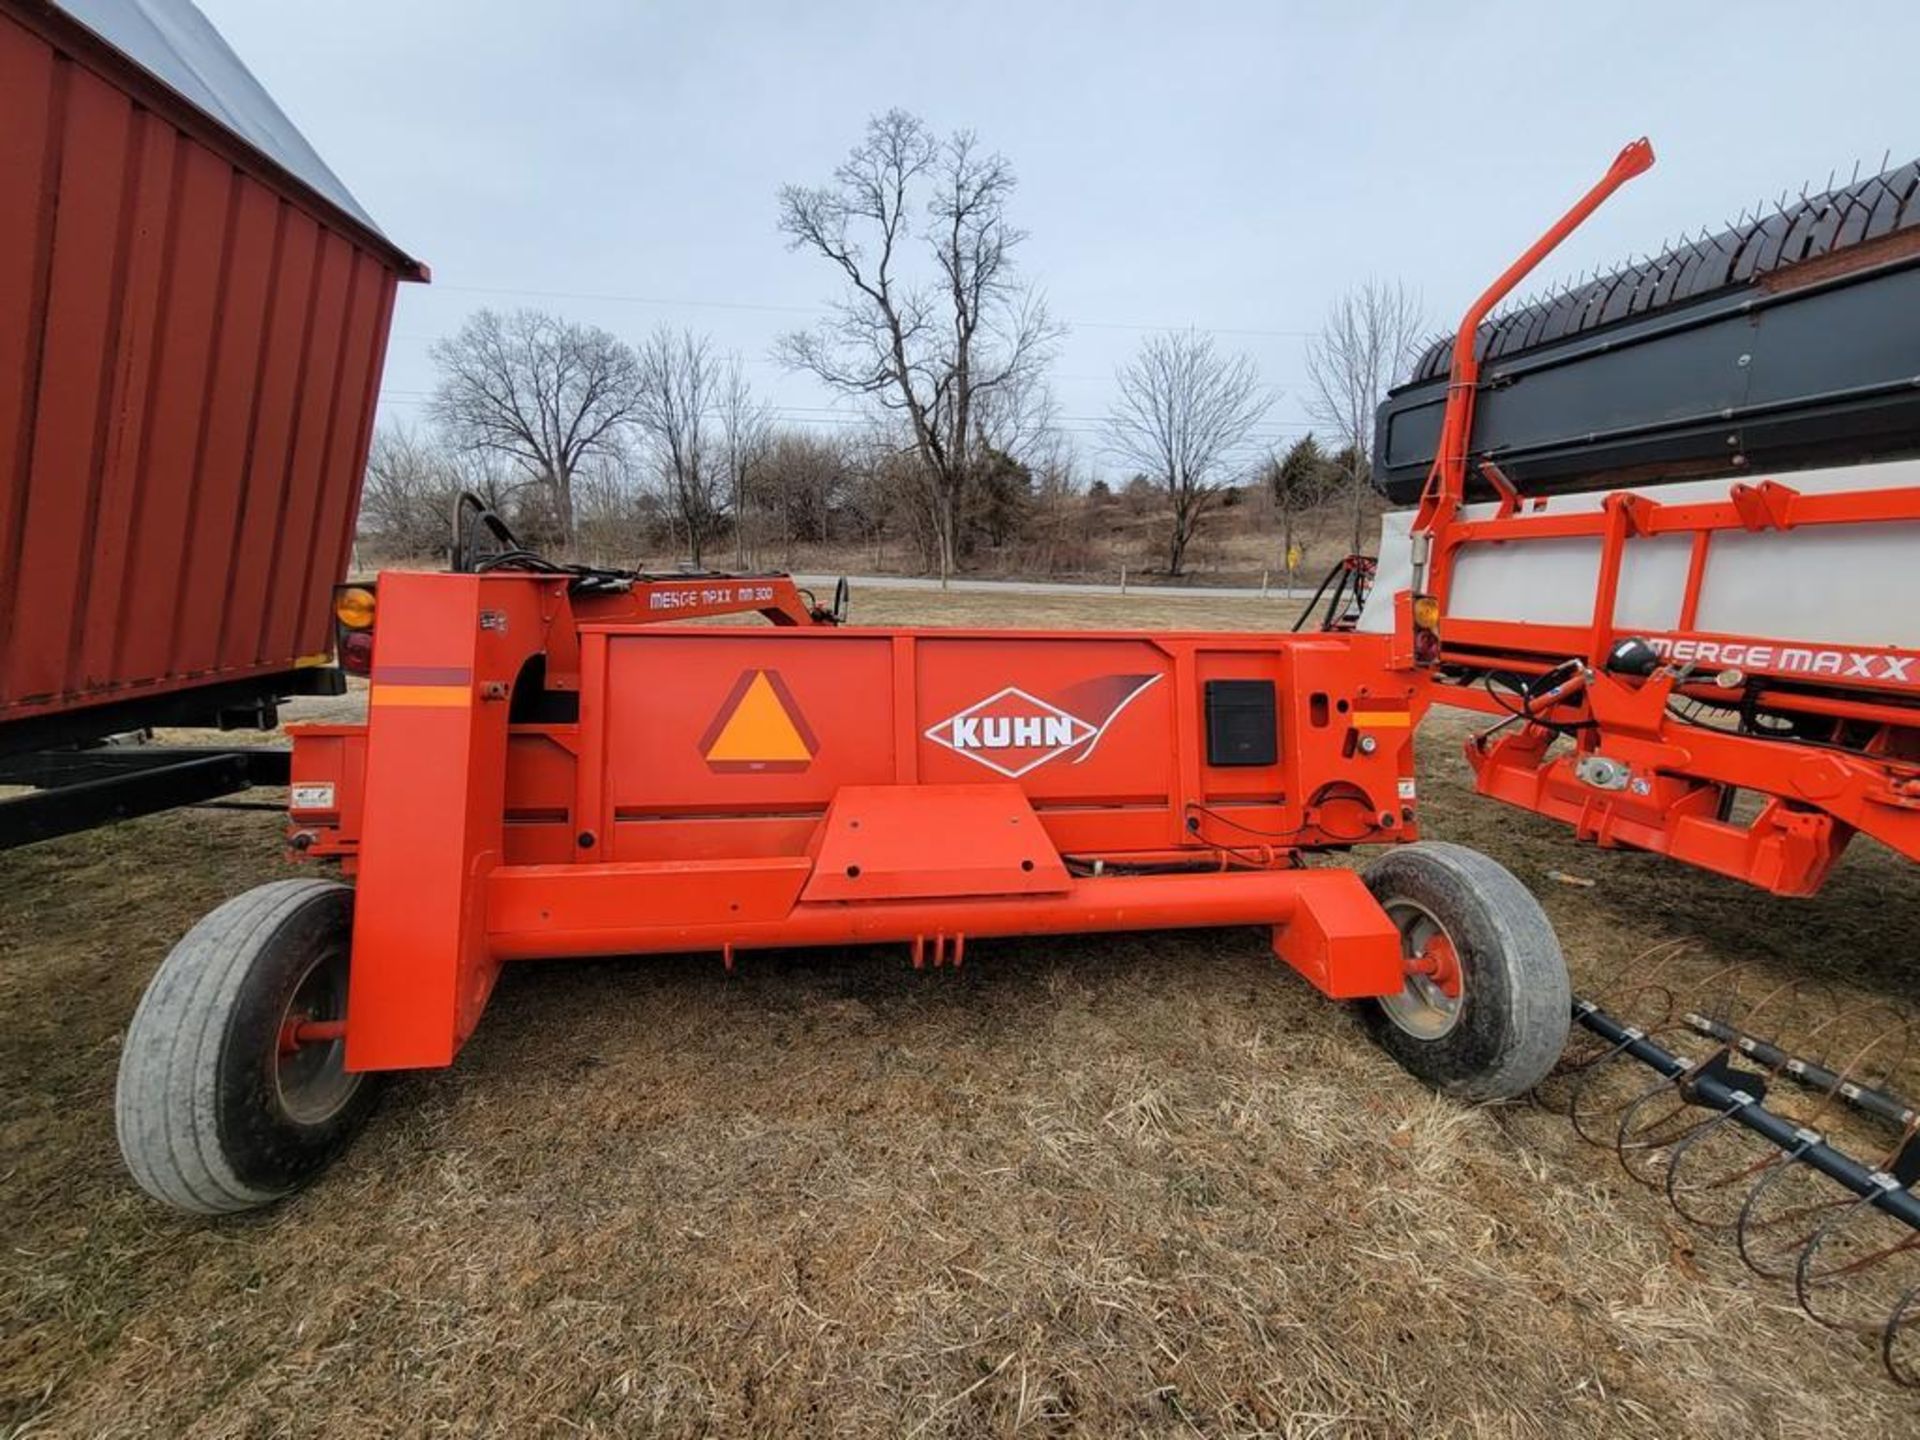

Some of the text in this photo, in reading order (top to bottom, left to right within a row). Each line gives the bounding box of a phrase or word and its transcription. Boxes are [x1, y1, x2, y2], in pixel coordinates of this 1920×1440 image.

[650, 592, 698, 609] MERGE
[1648, 638, 1914, 682] MERGE MAXX
[952, 716, 1073, 748] KUHN
